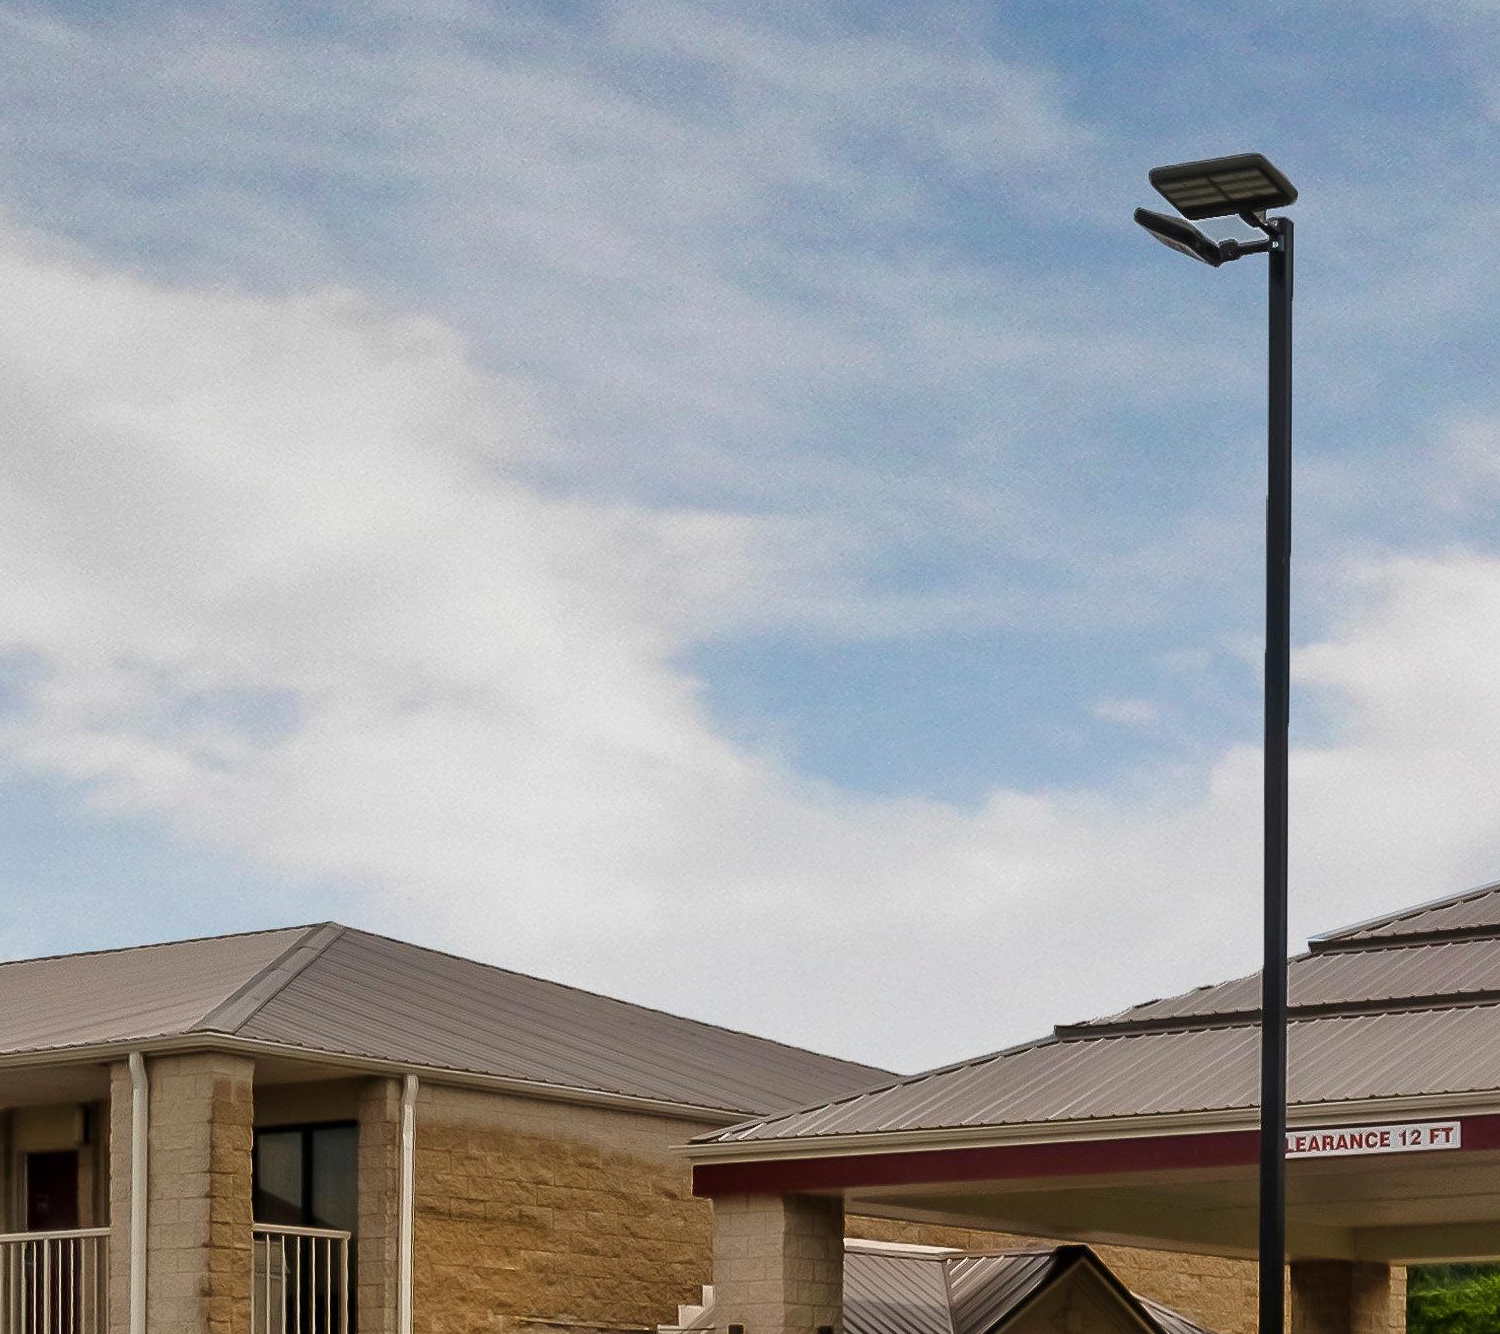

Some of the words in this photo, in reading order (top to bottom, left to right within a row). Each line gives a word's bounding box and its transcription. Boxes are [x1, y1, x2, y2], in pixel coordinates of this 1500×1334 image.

[1284, 1131, 1391, 1153] LEARANCE
[1398, 1129, 1422, 1147] 12
[1429, 1127, 1454, 1145] FT
